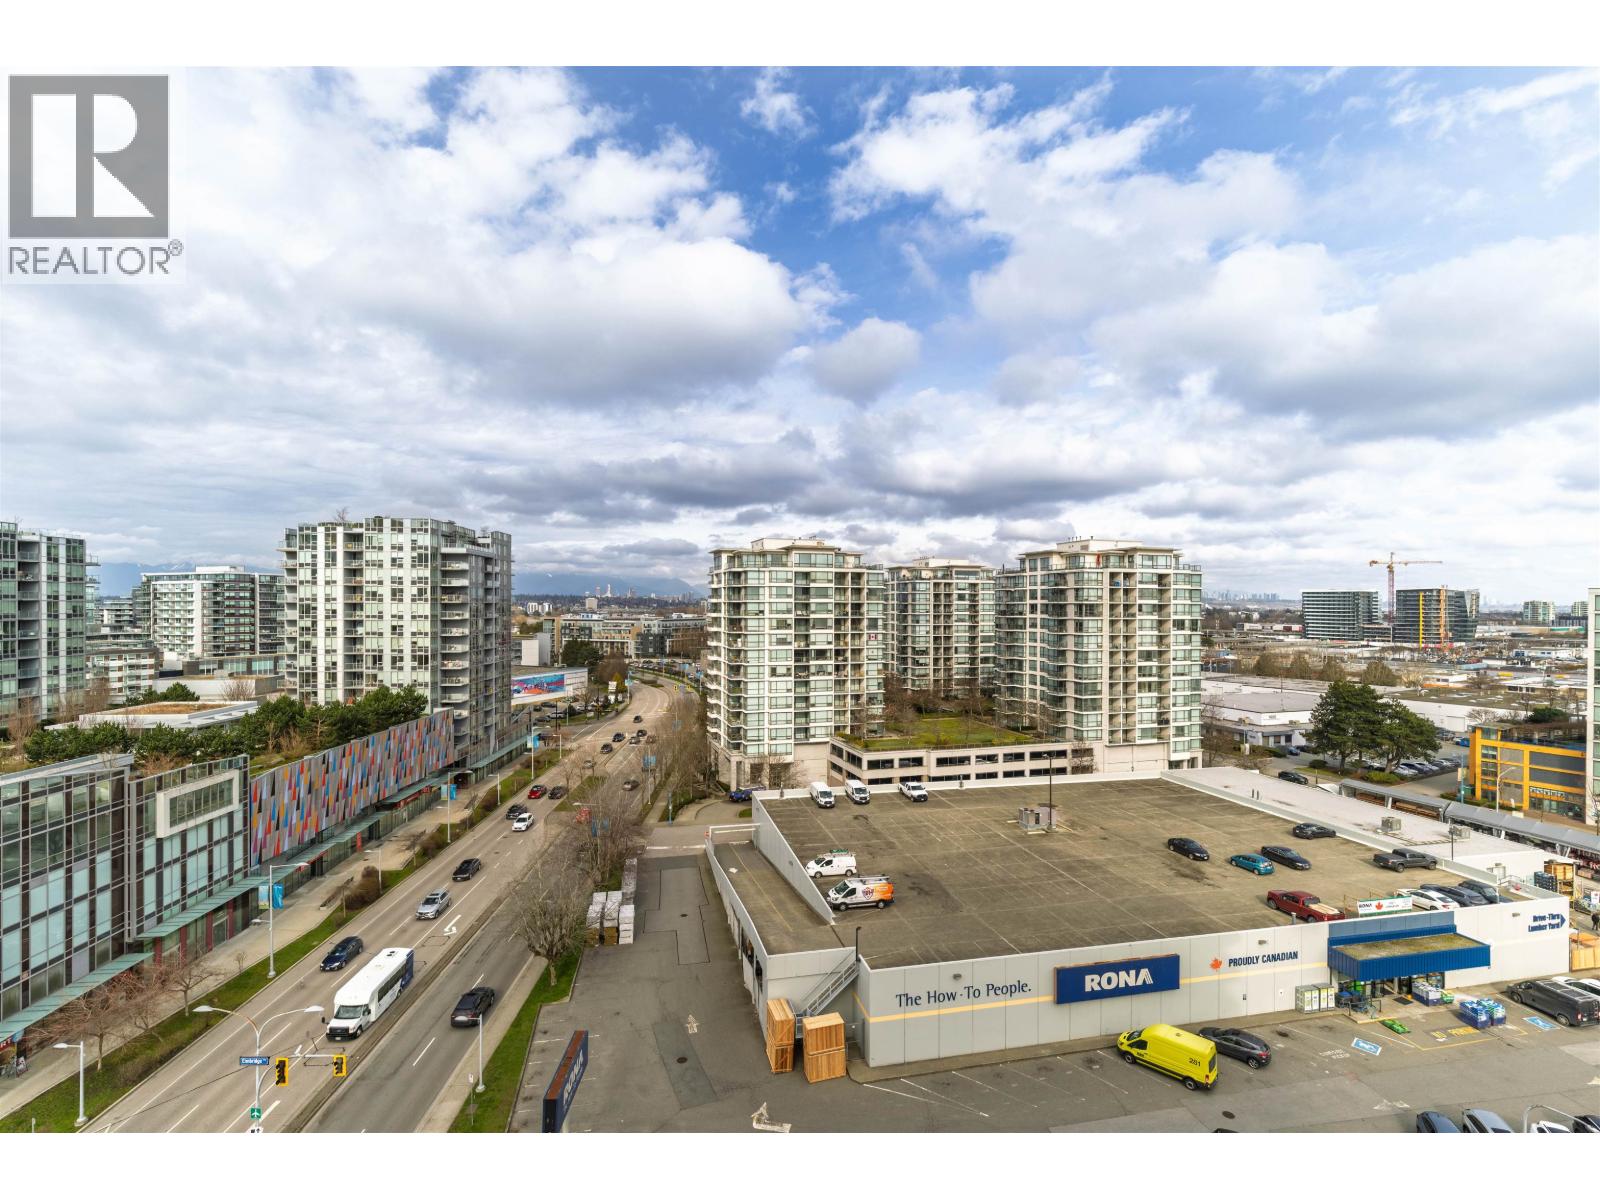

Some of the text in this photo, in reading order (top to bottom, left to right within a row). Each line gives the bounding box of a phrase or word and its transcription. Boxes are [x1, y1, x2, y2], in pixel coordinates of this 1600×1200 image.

[1228, 950, 1298, 967] PROUDLY CANADIAN
[1084, 968, 1154, 992] RONA
[895, 993, 922, 1008] The
[985, 980, 1032, 998] People.
[1188, 1057, 1201, 1067] 281
